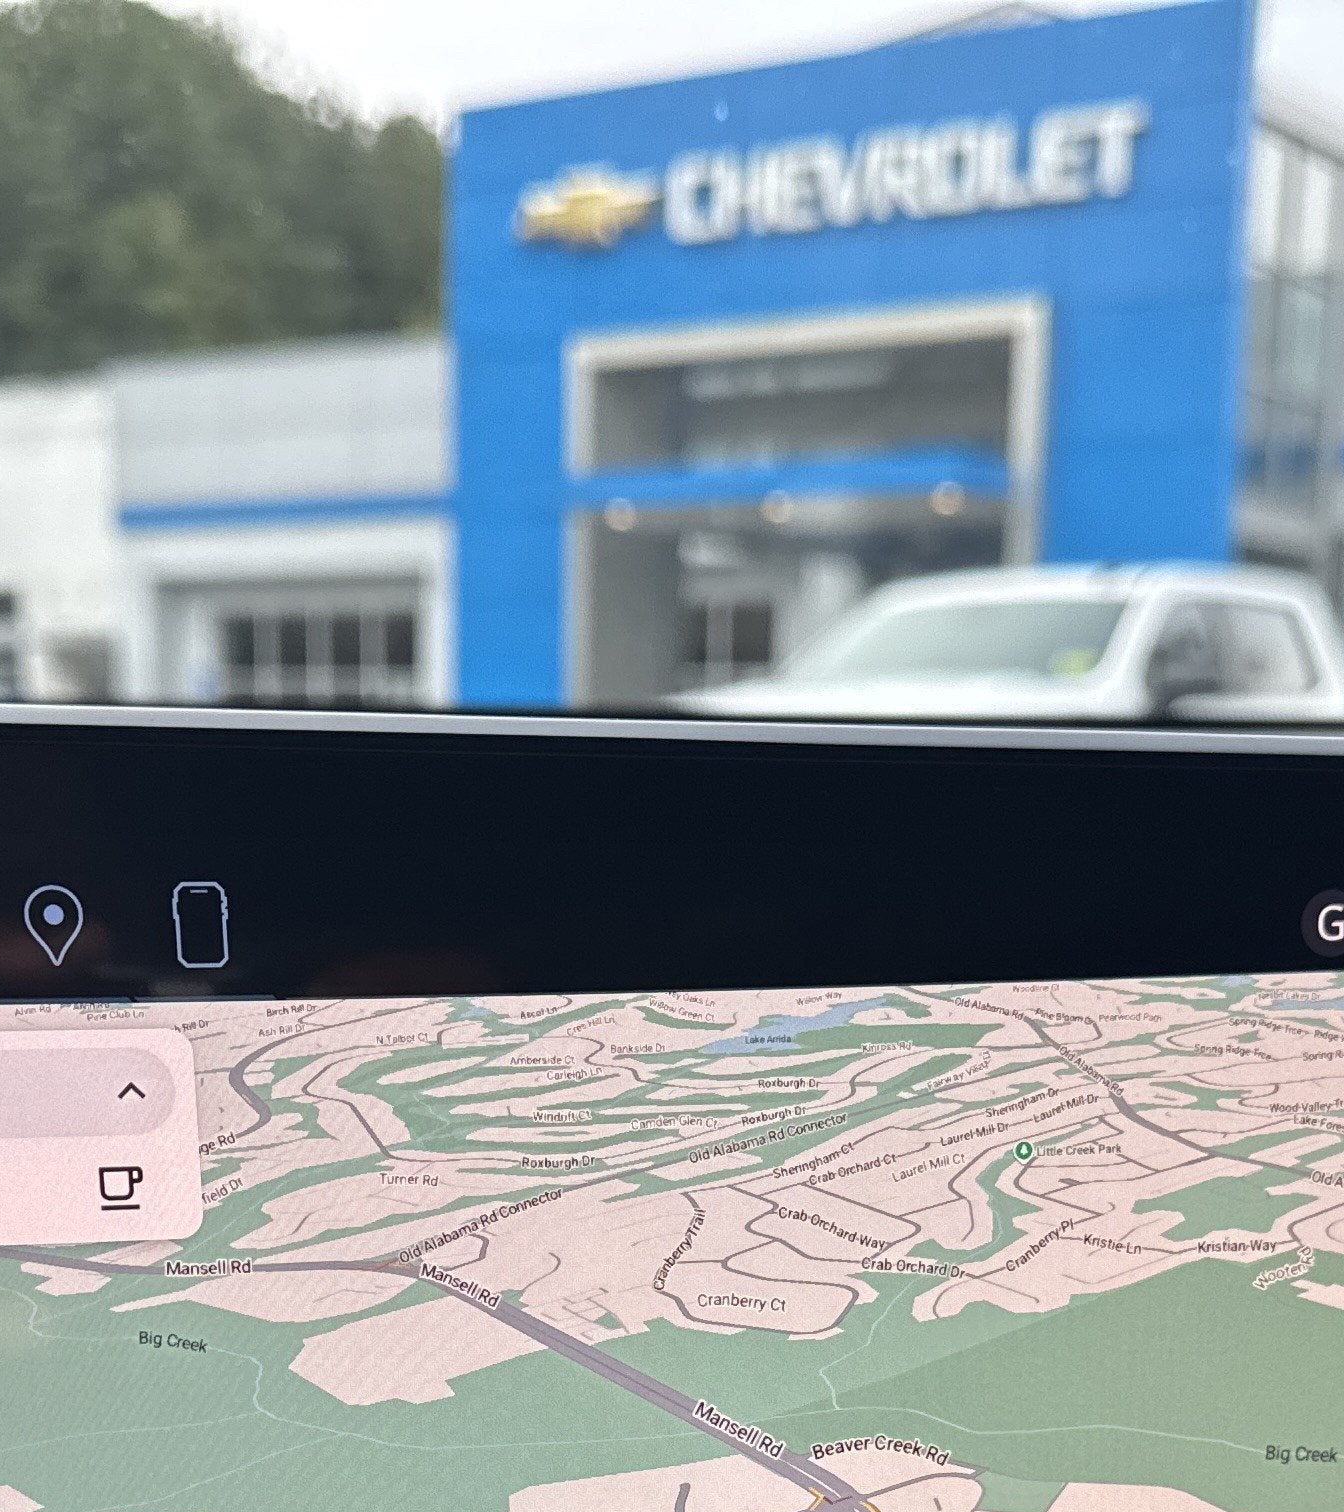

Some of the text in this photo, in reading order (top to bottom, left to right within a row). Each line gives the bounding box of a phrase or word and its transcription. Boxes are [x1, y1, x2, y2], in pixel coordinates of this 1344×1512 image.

[662, 98, 1149, 246] CHEVROLET
[955, 996, 1024, 1020] Old Alabama Rd
[745, 1035, 765, 1044] Lake
[1059, 1045, 1124, 1096] Old Alabama Rd
[758, 1077, 820, 1091] Roxburgh Dr
[679, 1116, 702, 1127] Glen
[741, 1105, 806, 1126] Roxburgh Dr
[689, 1112, 847, 1163] Old Alabama Rd Connector
[940, 1130, 972, 1147] Laurel
[1037, 1142, 1122, 1157] Little Creek Park
[522, 1155, 595, 1170] Roxburgh Dr
[808, 1171, 836, 1186] Crab
[838, 1159, 881, 1178] Orchard
[891, 1163, 927, 1183] Laurel
[928, 1157, 950, 1172] Mill
[379, 1173, 439, 1187] Turner Rd
[1312, 1170, 1333, 1184] Old
[399, 1188, 563, 1263] Old Alabama Rd Connector
[778, 1206, 886, 1251] Crab Orchard Way
[653, 1208, 706, 1291] Cranberry Trail
[1005, 1230, 1060, 1273] Cranberry
[1083, 1234, 1142, 1255] Kristie Ln
[1197, 1239, 1277, 1254] Kristian Way
[166, 1259, 251, 1275] Mansell Rd
[861, 1257, 967, 1278] Crab Orchard Dr
[421, 1263, 499, 1307] Mansell Rd
[697, 1293, 786, 1312] Cranberry Ct
[139, 1331, 207, 1352] Big Creek
[693, 1400, 785, 1458] Mansell Rd
[812, 1434, 950, 1466] Beaver Creek Rd
[1265, 1444, 1338, 1465] Big Creek
